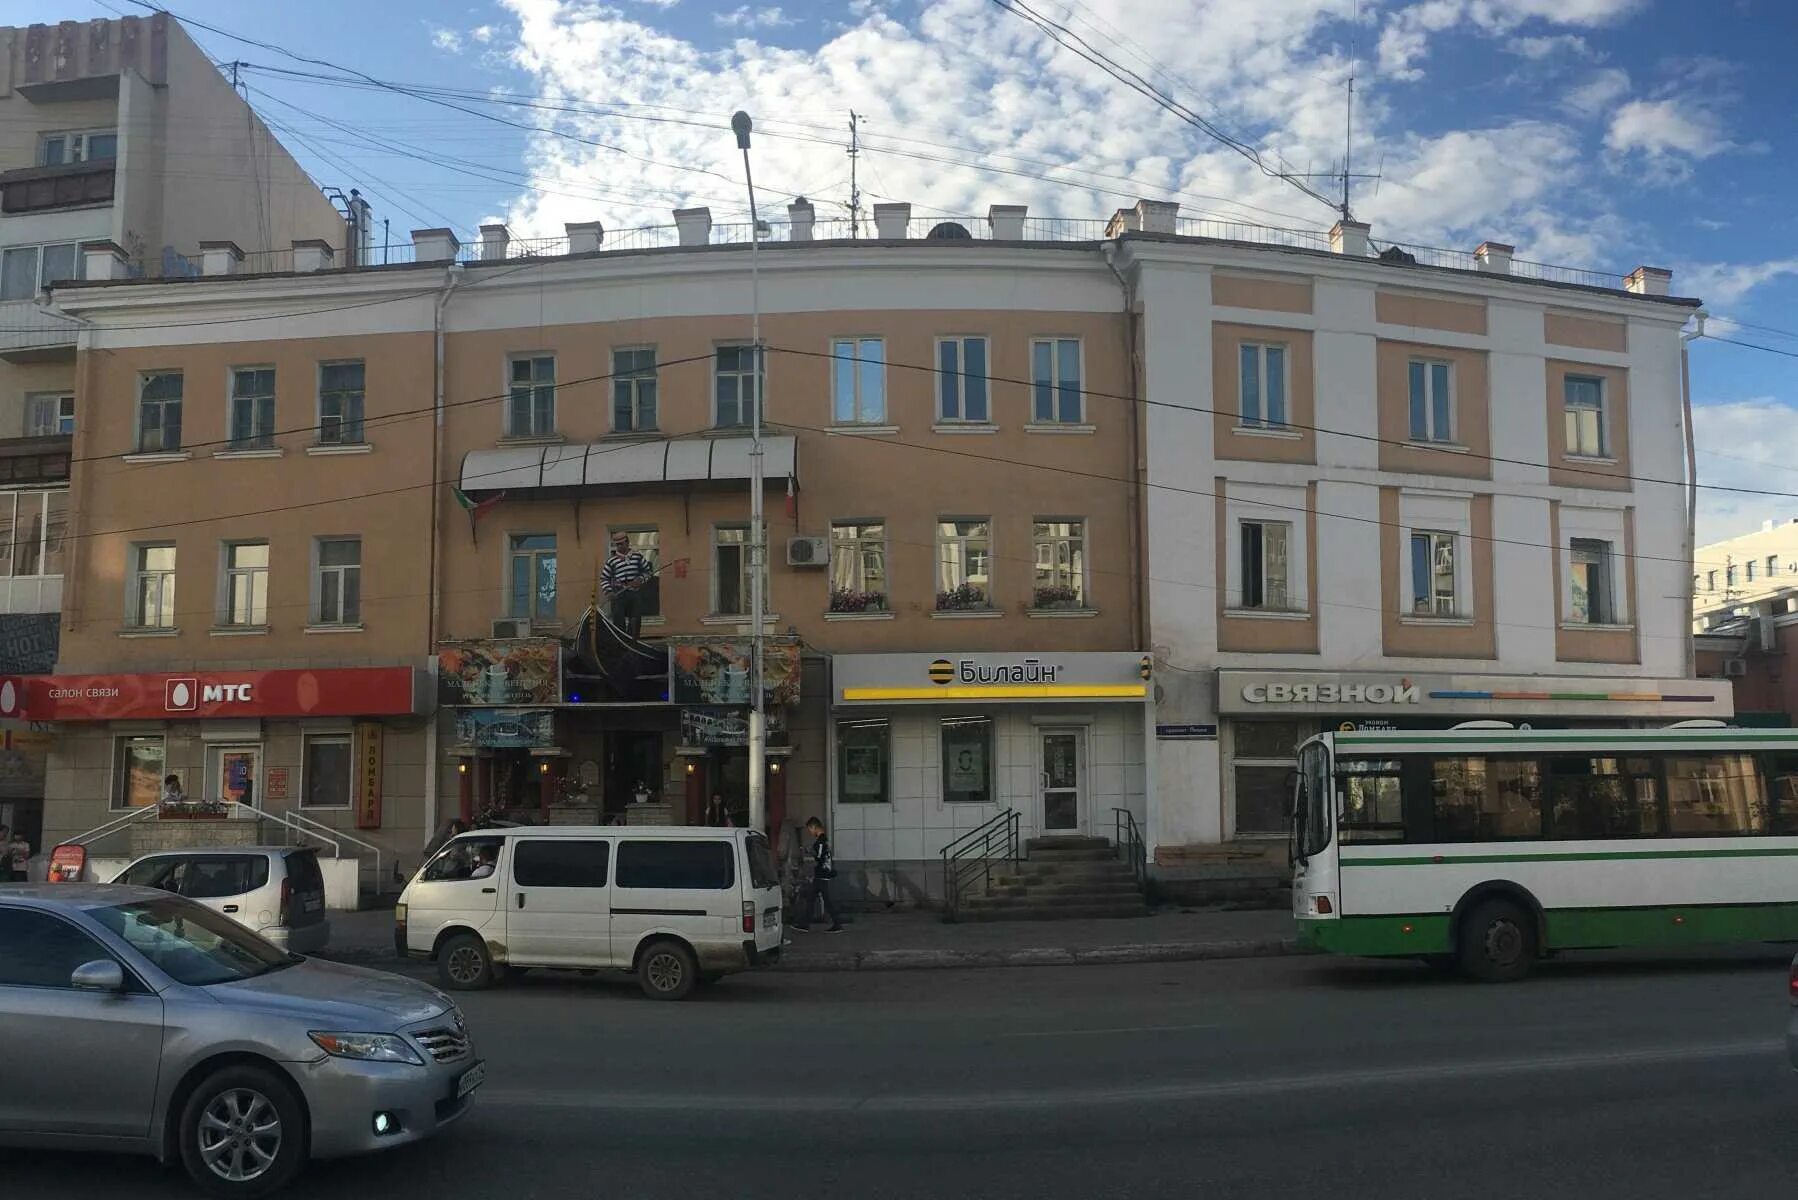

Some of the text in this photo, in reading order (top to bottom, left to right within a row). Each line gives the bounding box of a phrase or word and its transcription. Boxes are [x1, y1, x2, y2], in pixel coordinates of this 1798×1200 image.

[960, 659, 1056, 684] Билайн
[48, 686, 119, 699] салон связи
[203, 683, 252, 702] МТС
[1241, 679, 1421, 704] СВЯЗНОЙ
[367, 745, 377, 820] ЛОМБАРД
